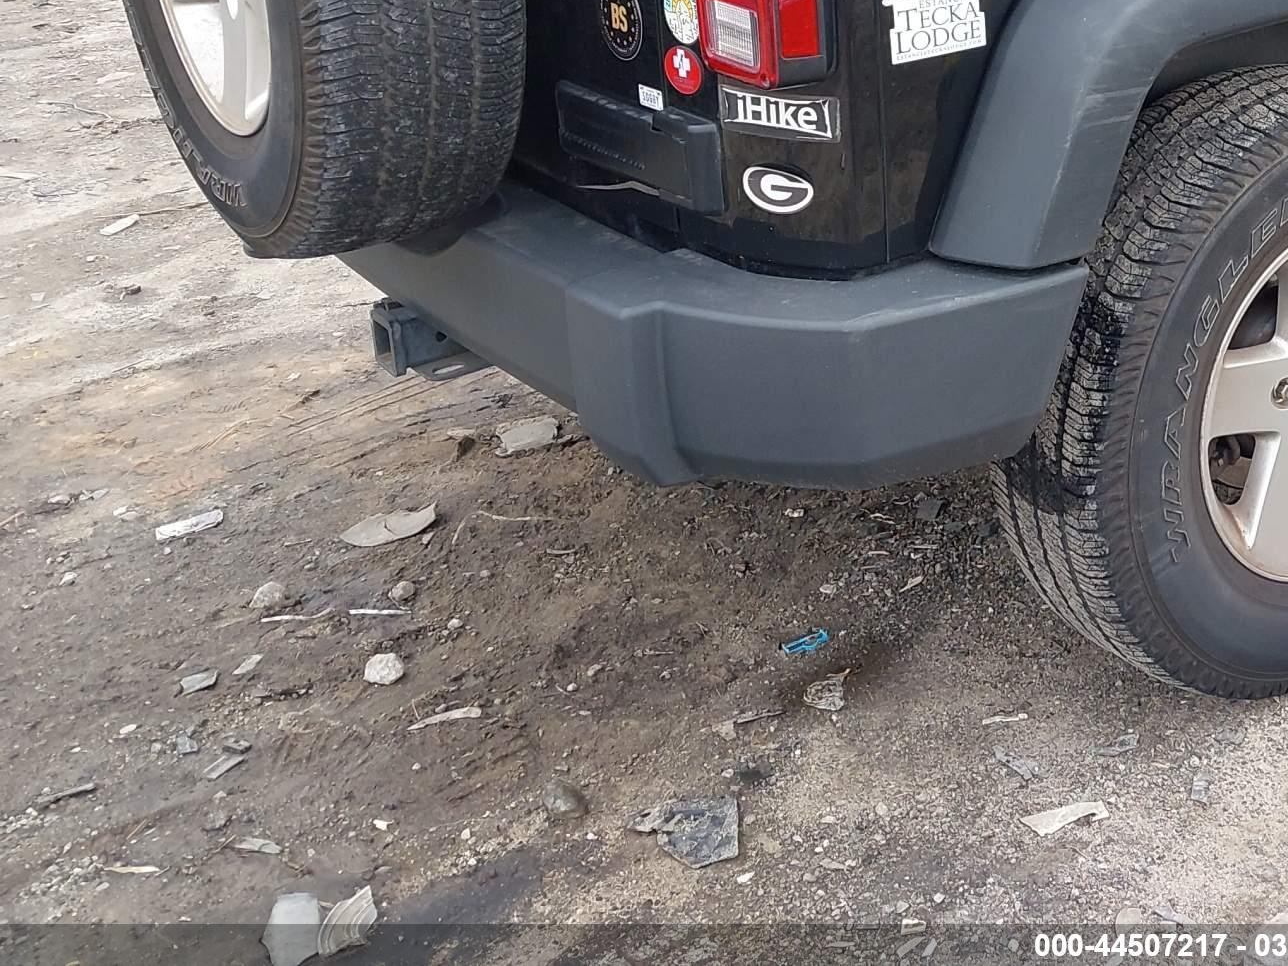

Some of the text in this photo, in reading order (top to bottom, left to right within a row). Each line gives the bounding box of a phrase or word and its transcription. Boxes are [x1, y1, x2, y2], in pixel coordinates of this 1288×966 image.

[610, 2, 628, 33] BS
[897, 1, 979, 32] TECKA
[895, 19, 982, 54] LODGE
[737, 94, 818, 130] iHike
[748, 169, 809, 208] G
